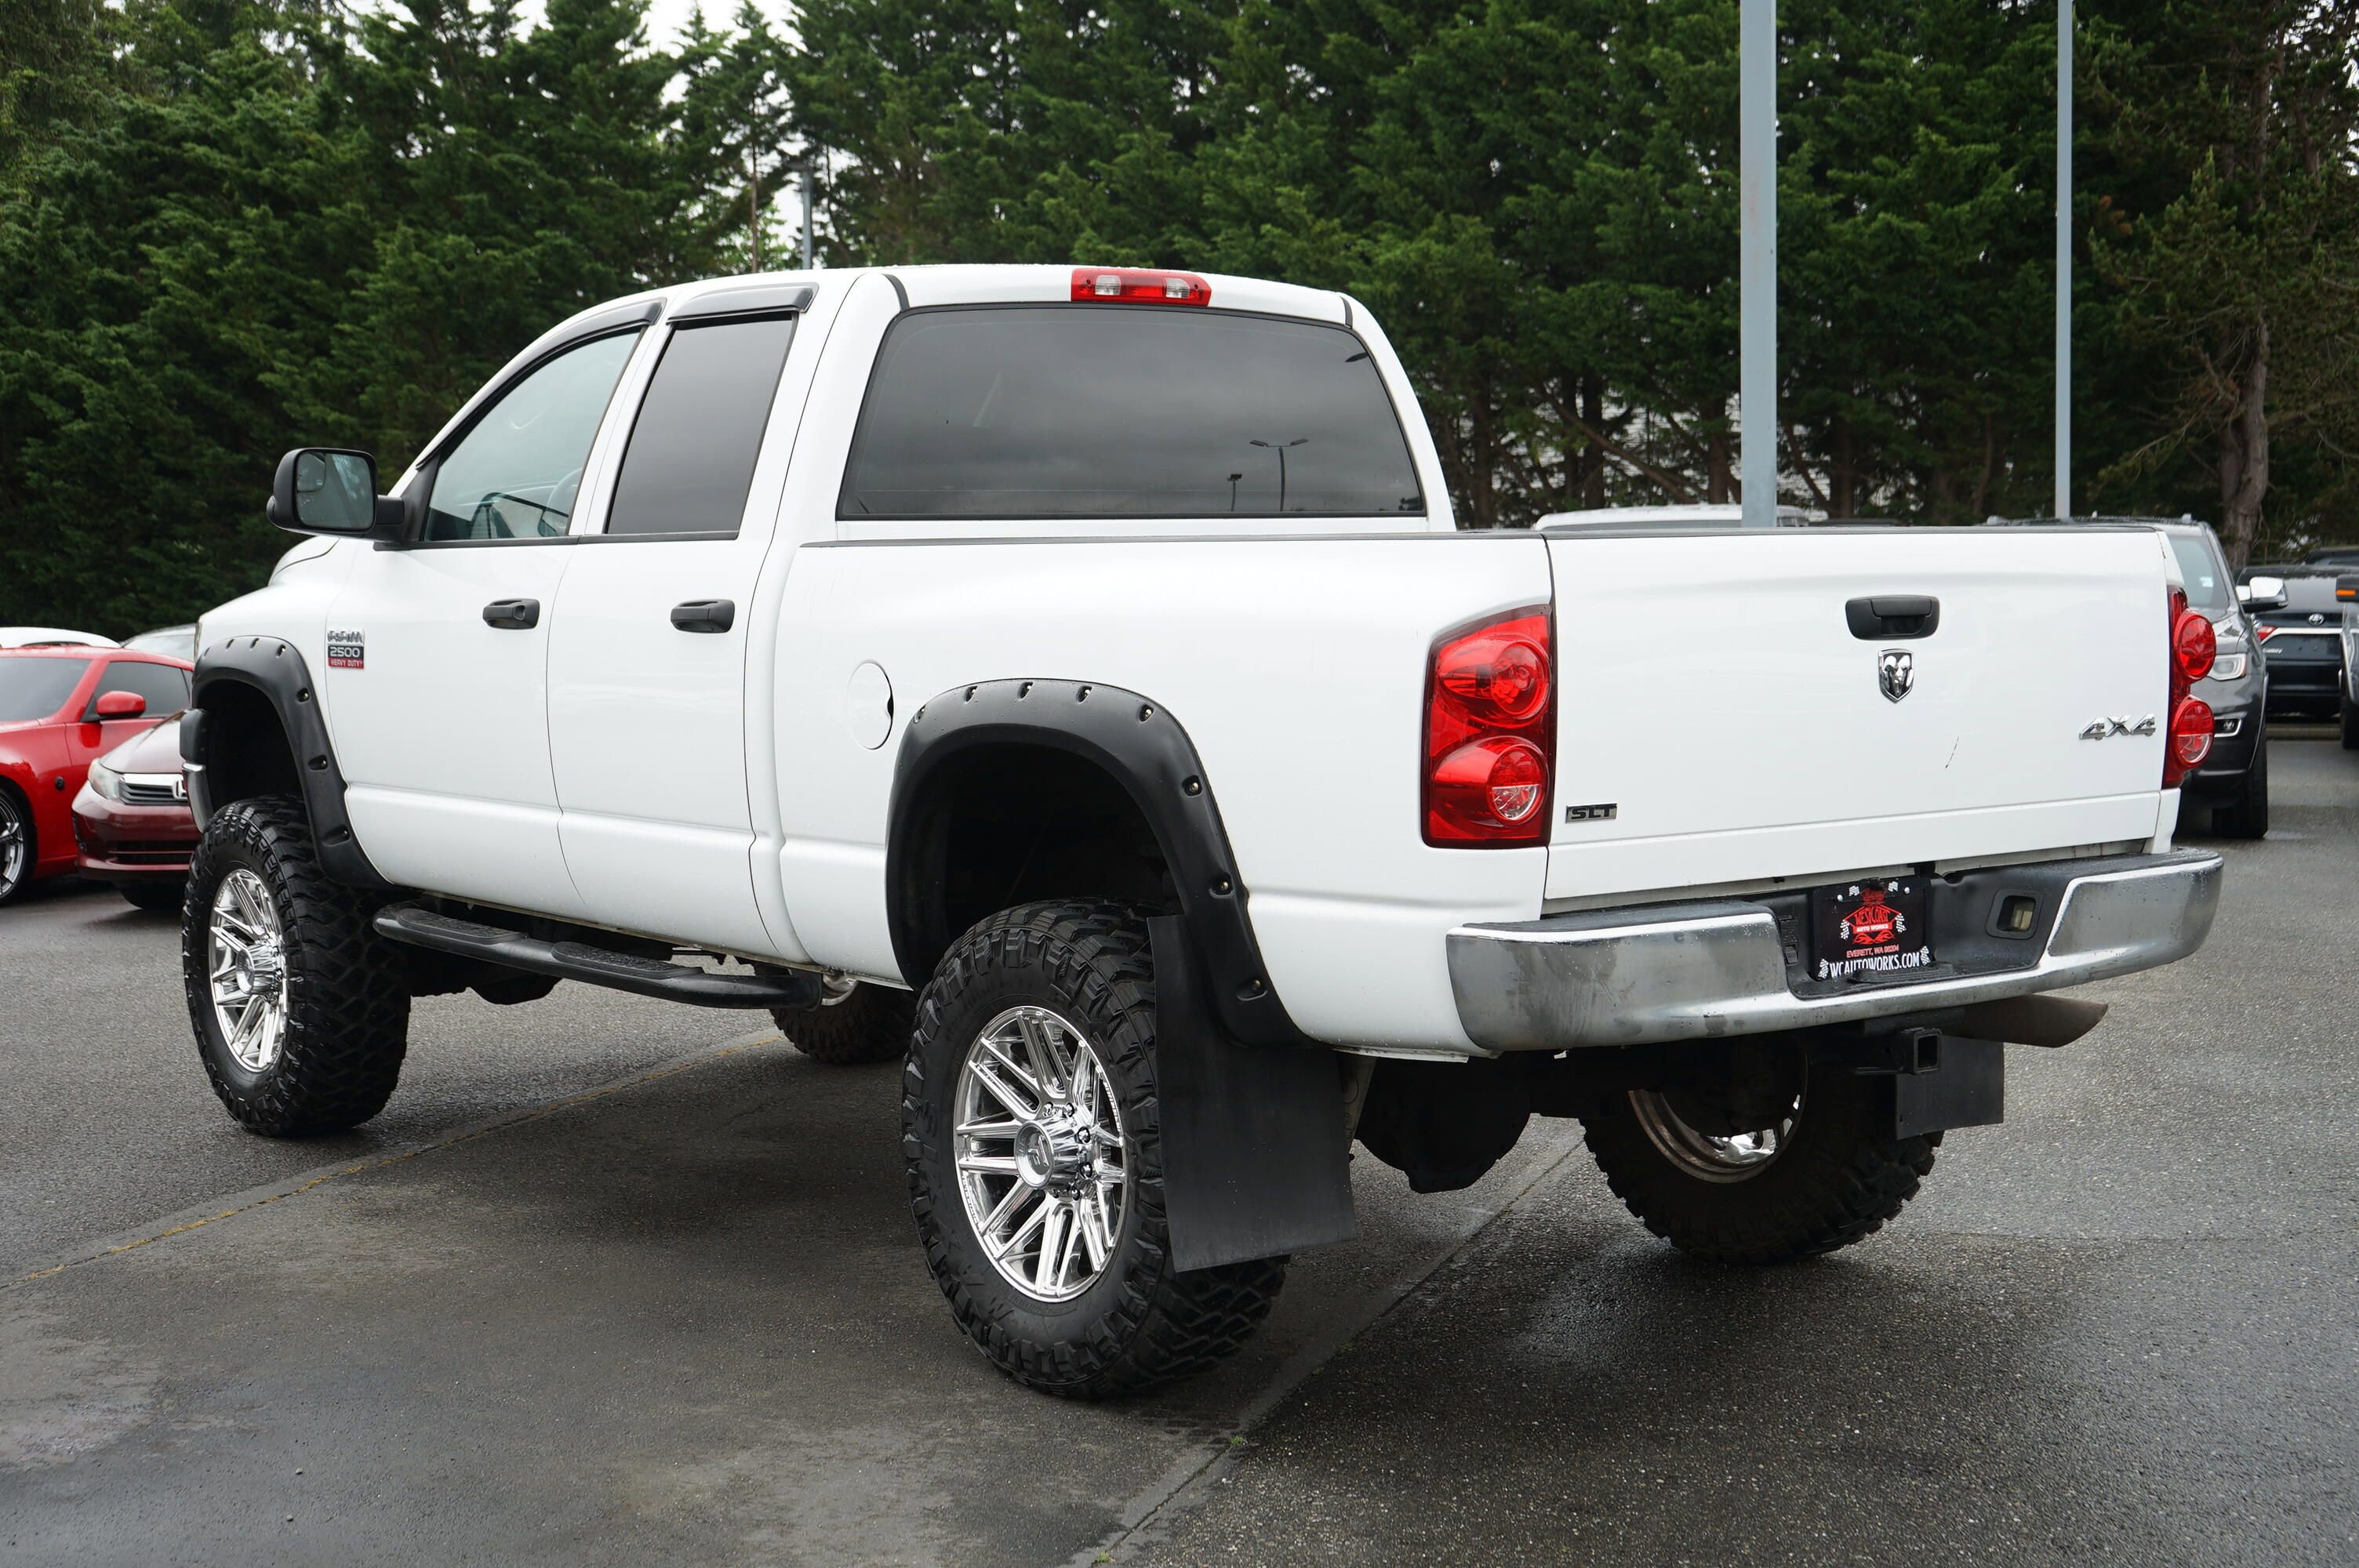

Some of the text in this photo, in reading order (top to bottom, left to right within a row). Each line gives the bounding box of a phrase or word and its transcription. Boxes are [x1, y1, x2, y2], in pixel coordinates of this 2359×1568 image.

[329, 647, 361, 658] 2500
[331, 659, 347, 667] HEAVY
[1571, 804, 1617, 820] SLT
[1870, 923, 1889, 931] WORKS
[1846, 947, 1874, 959] EVERETT,
[1874, 946, 1884, 955] WA
[1829, 952, 1920, 978] WCAUTOWORKS.COM
